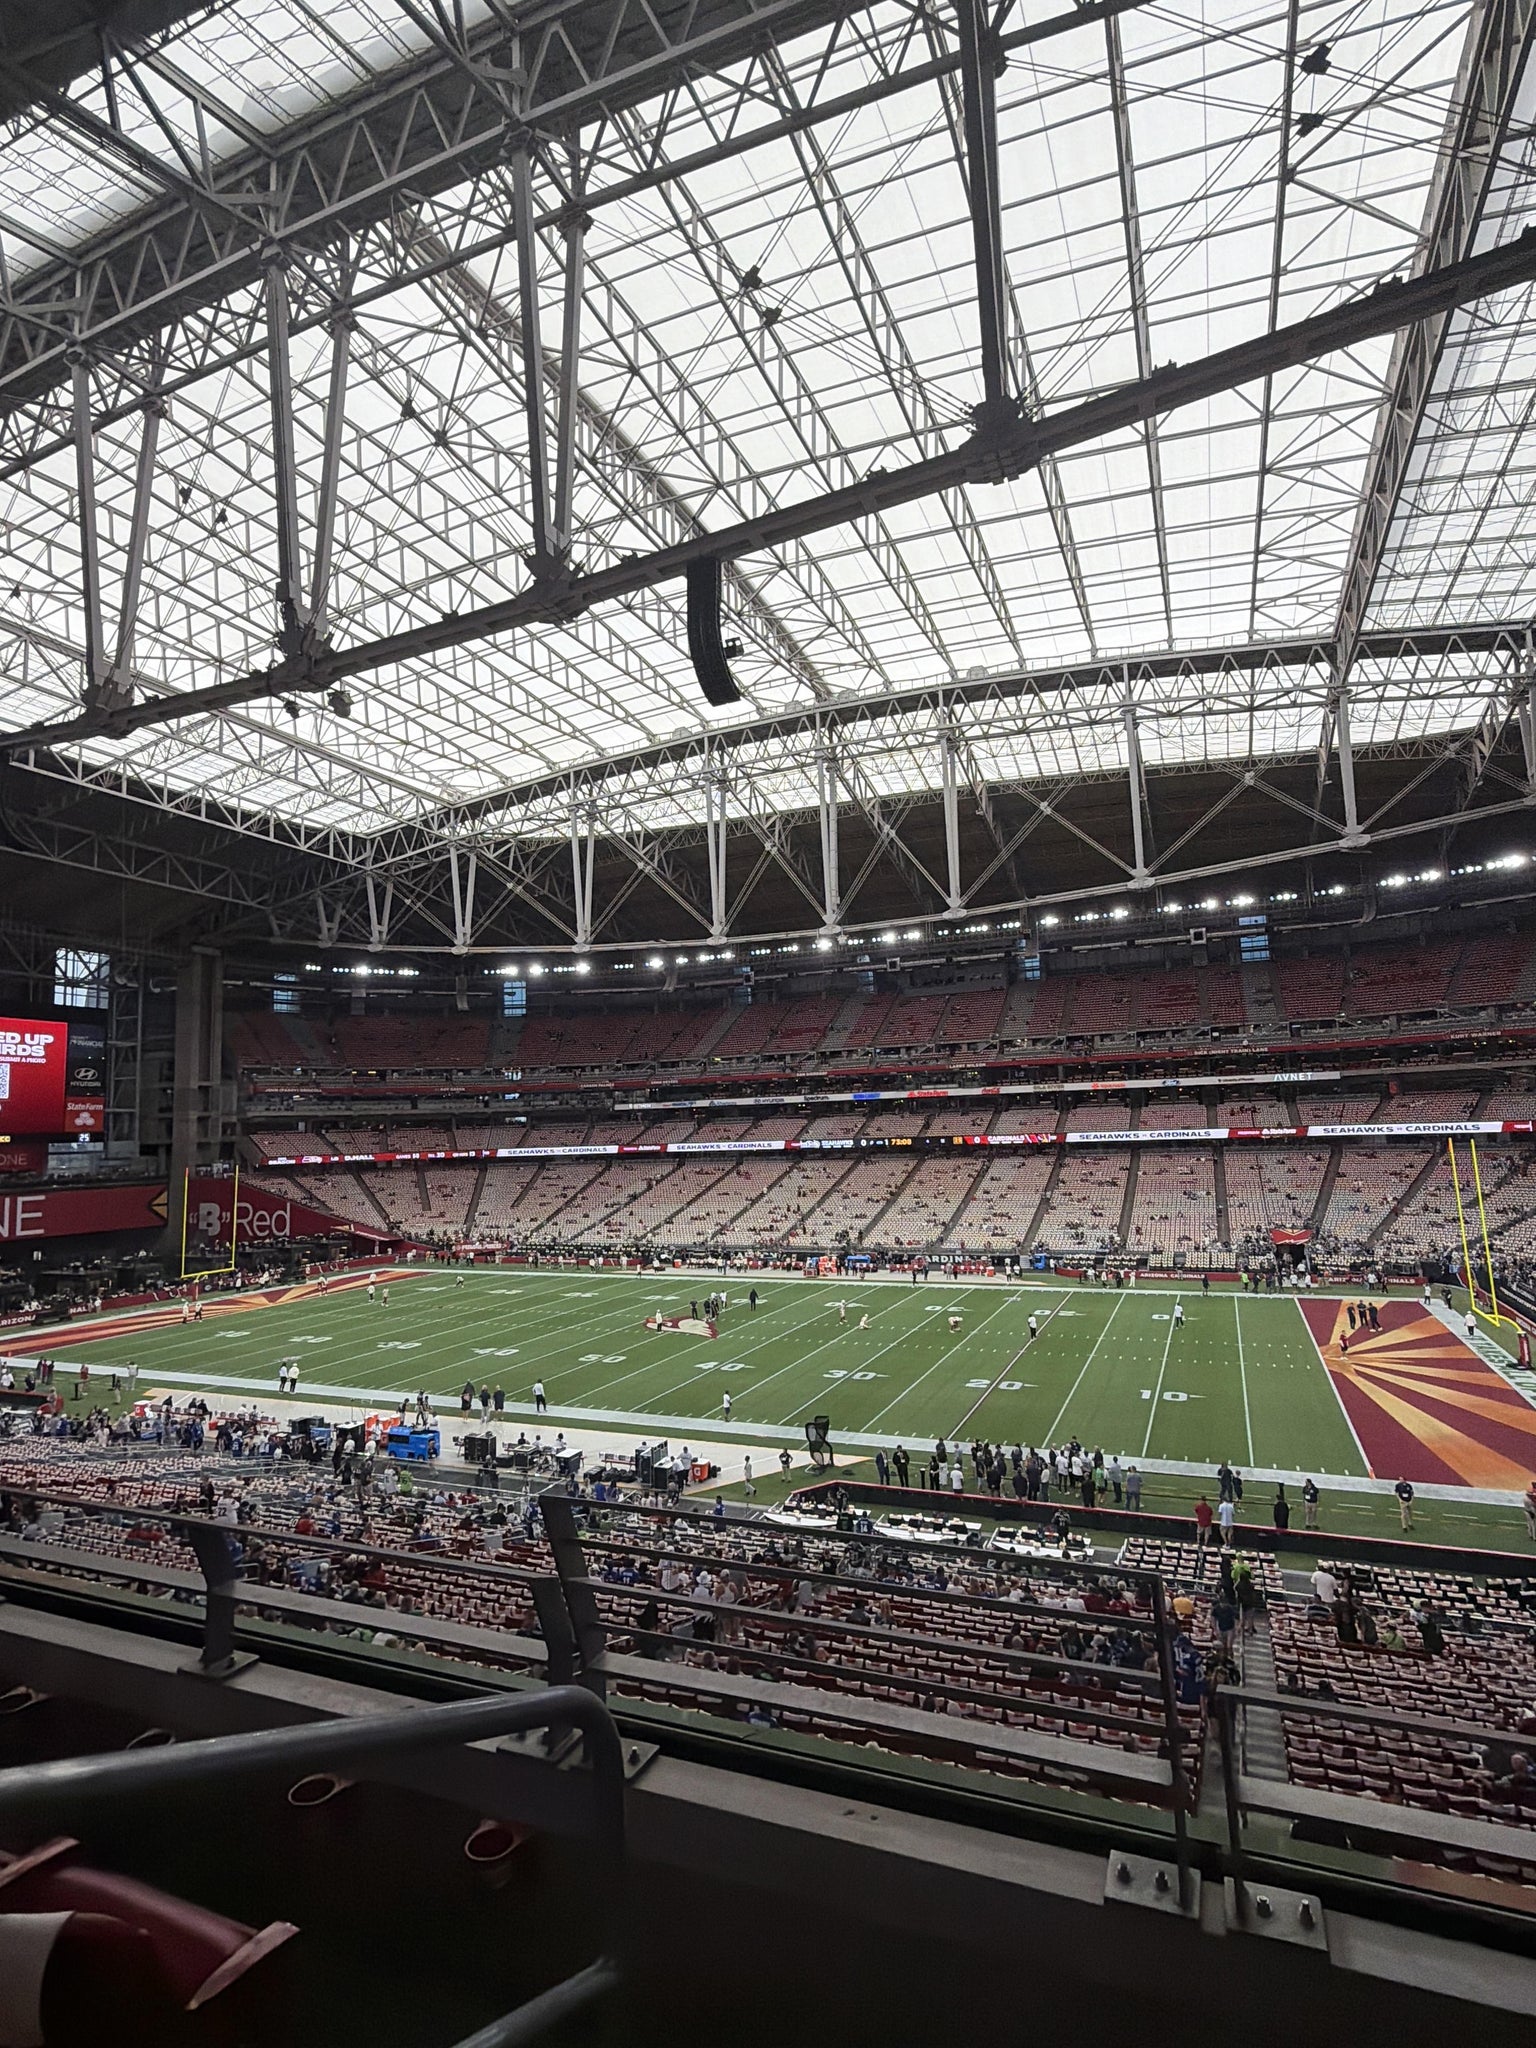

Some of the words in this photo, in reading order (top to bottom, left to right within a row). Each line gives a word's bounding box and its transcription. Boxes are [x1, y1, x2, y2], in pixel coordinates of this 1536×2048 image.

[24, 1034, 54, 1045] UP
[1274, 1072, 1313, 1081] AVNET
[1322, 1126, 1394, 1134] SEAHAWKS
[1405, 1124, 1481, 1132] CARDINALS
[79, 1133, 90, 1142] 25
[236, 1202, 290, 1236] Red
[471, 1347, 520, 1356] 40
[578, 1353, 627, 1363] 50
[694, 1361, 746, 1371] 40
[823, 1369, 877, 1381] 30
[965, 1378, 1024, 1390] 20
[1140, 1389, 1188, 1401] 10
